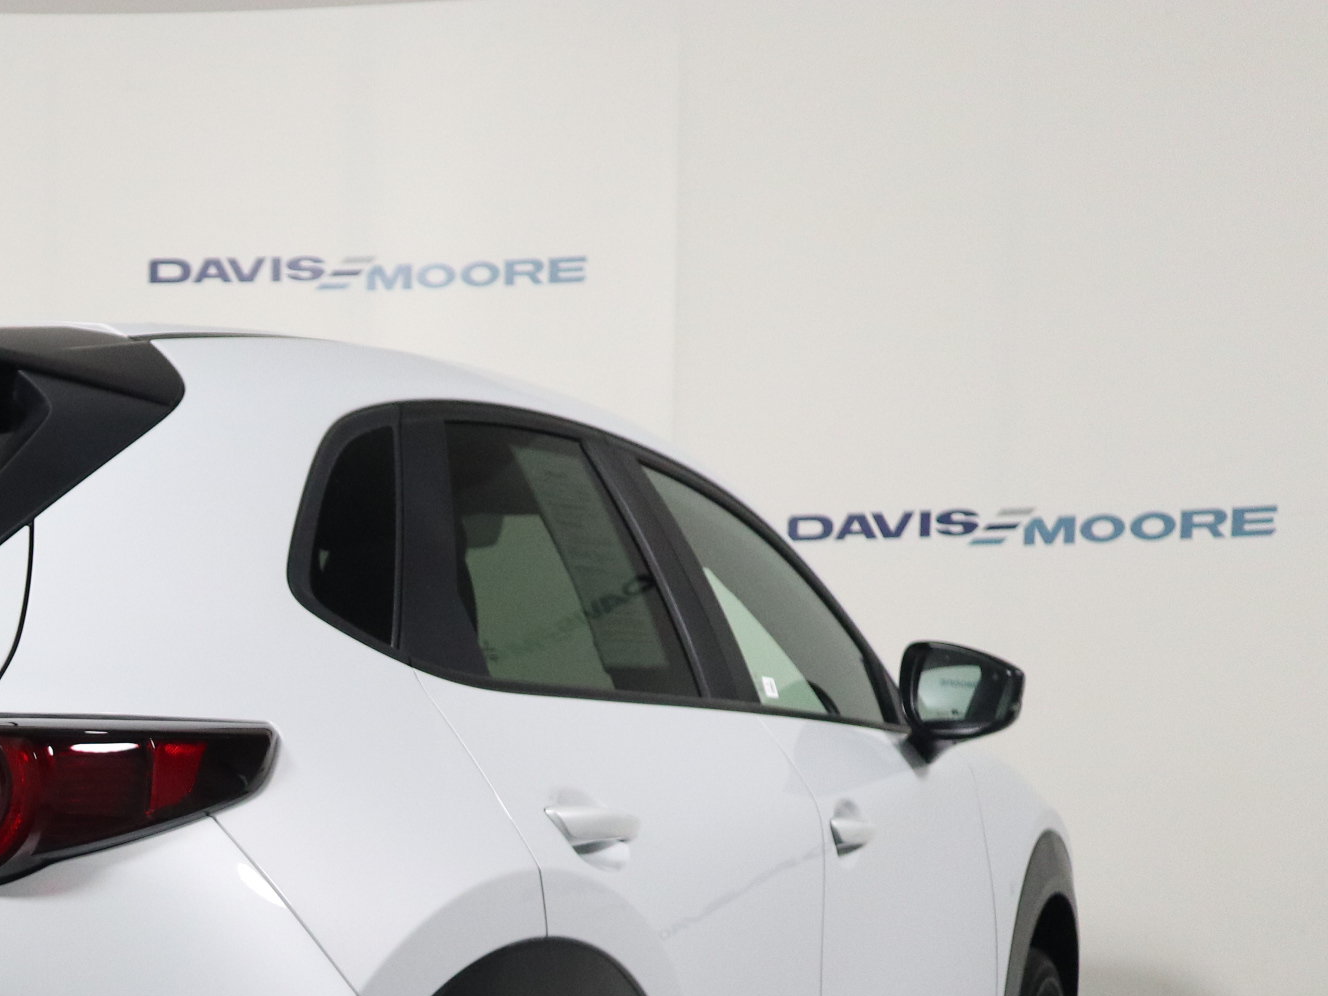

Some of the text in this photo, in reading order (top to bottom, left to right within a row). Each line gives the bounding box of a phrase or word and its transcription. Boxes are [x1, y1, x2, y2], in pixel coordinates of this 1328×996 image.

[148, 255, 587, 291] DAVIS MOORE
[787, 505, 1278, 547] DAVIS MOORE
